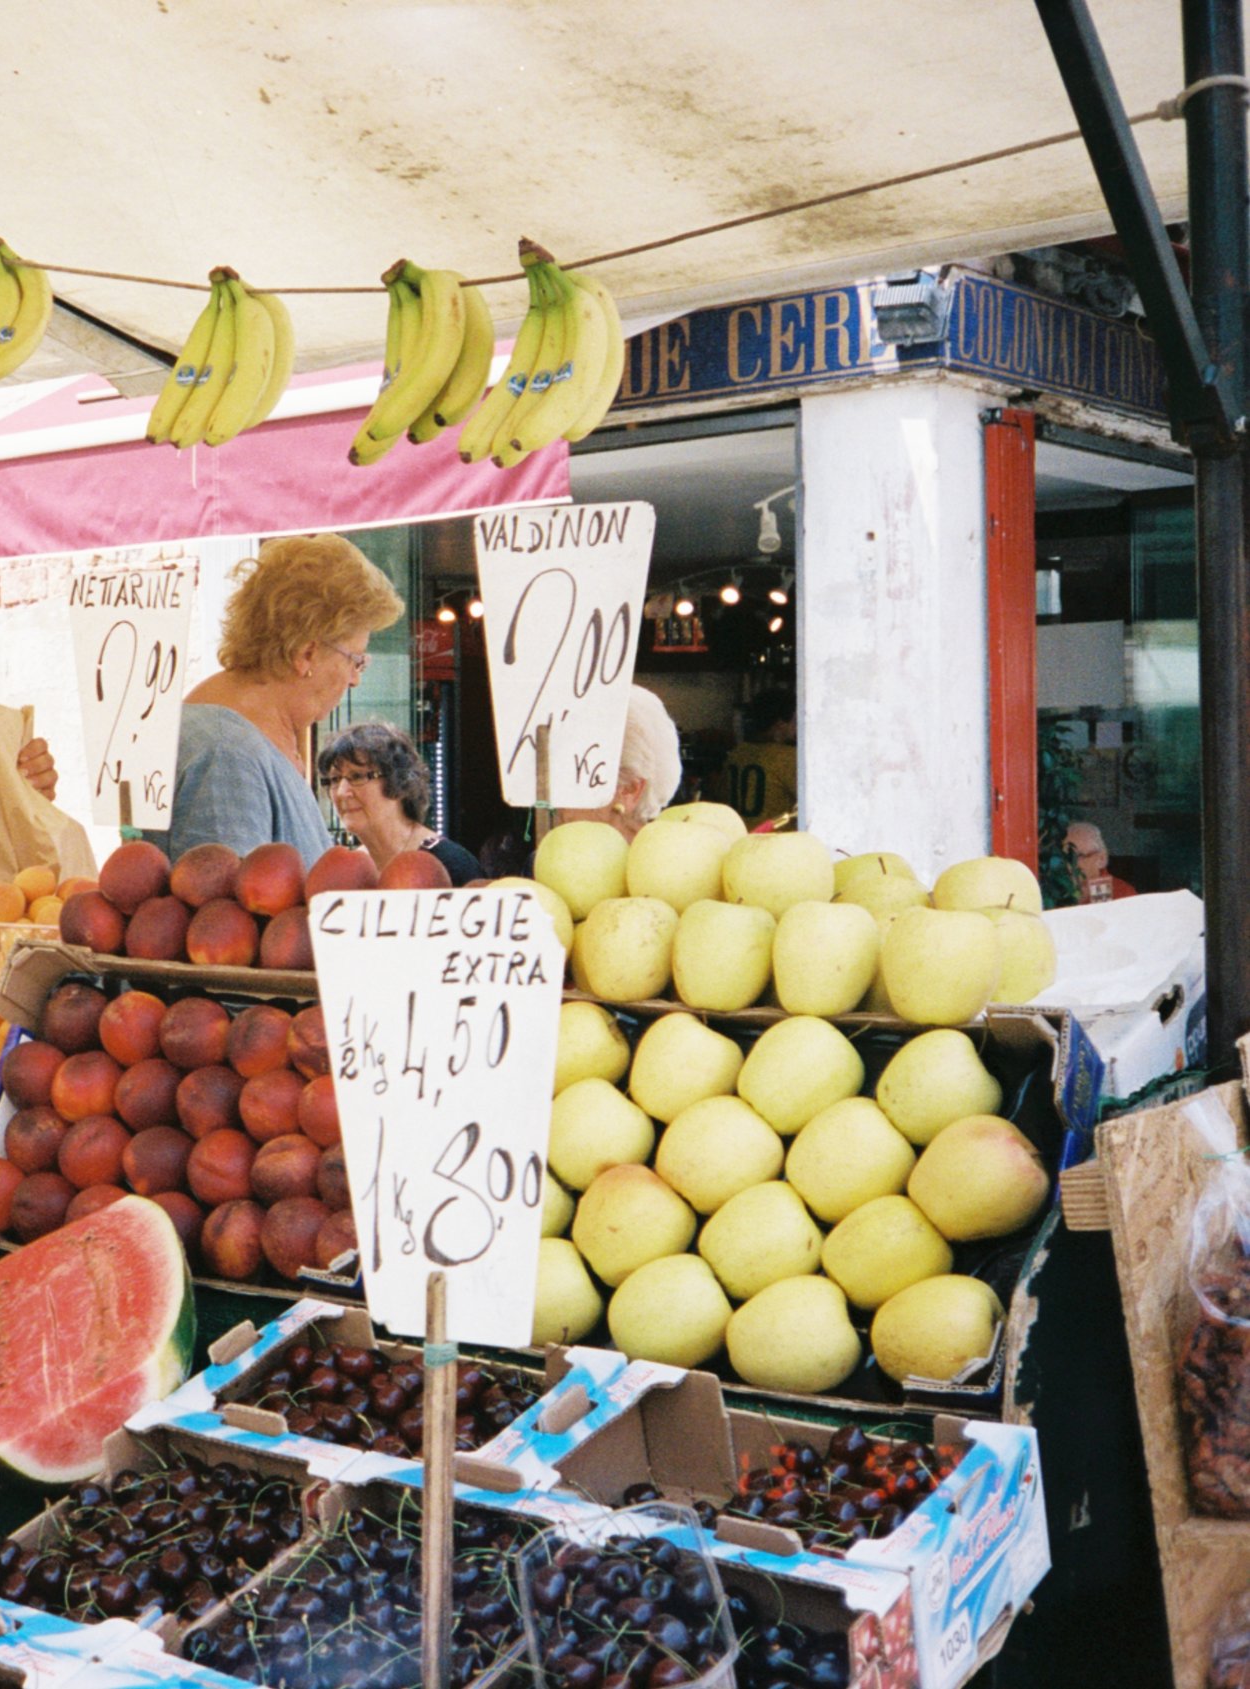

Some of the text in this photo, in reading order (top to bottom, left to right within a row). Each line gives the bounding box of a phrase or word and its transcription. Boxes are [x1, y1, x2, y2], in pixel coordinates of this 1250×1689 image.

[957, 278, 1097, 393] COLONIALI
[69, 571, 185, 609] NETTARINE
[319, 891, 534, 942] CILIEGIE
[440, 950, 548, 986] EXTRA
[401, 991, 512, 1108] 4,50
[422, 1120, 543, 1267] 8,00
